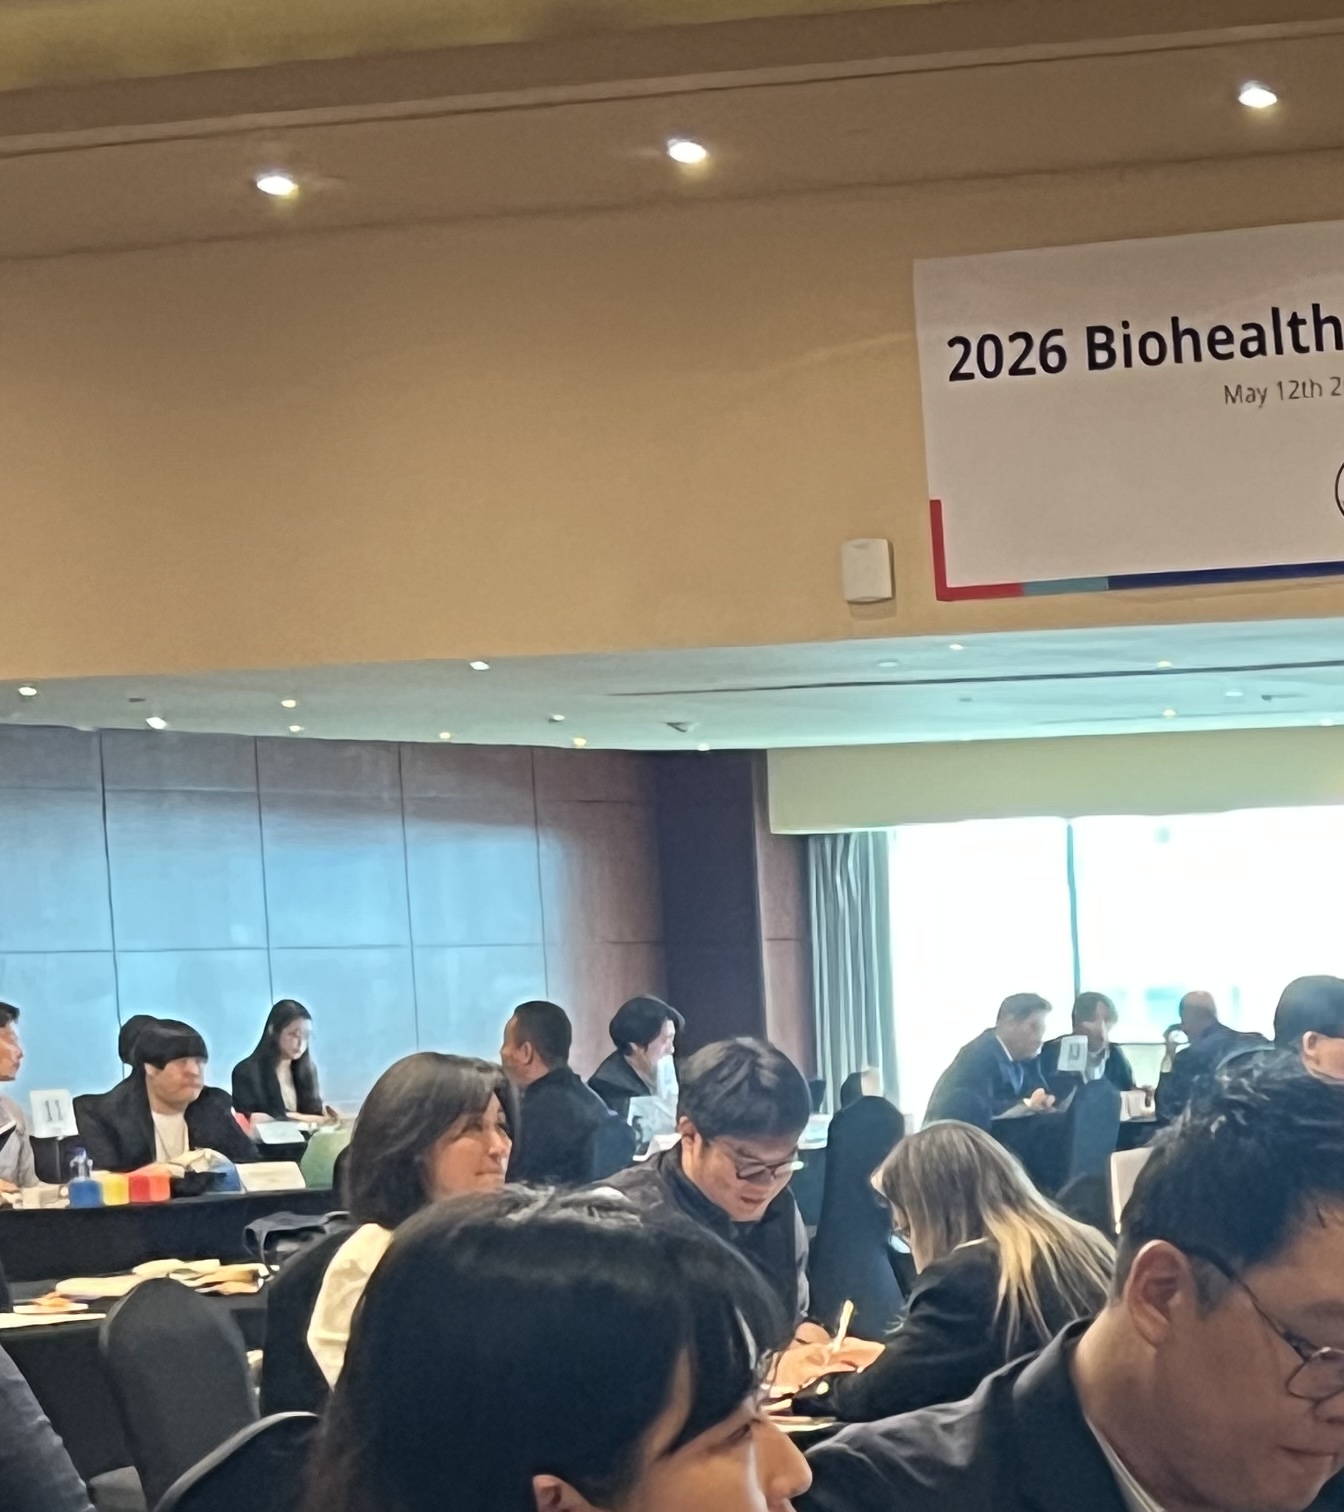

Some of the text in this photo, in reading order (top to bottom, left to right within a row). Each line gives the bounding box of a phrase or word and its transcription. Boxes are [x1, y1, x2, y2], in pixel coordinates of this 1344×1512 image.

[947, 328, 1068, 382] 2026
[1085, 302, 1344, 371] Biohealth
[1223, 384, 1268, 408] May
[1276, 379, 1323, 401] 12th
